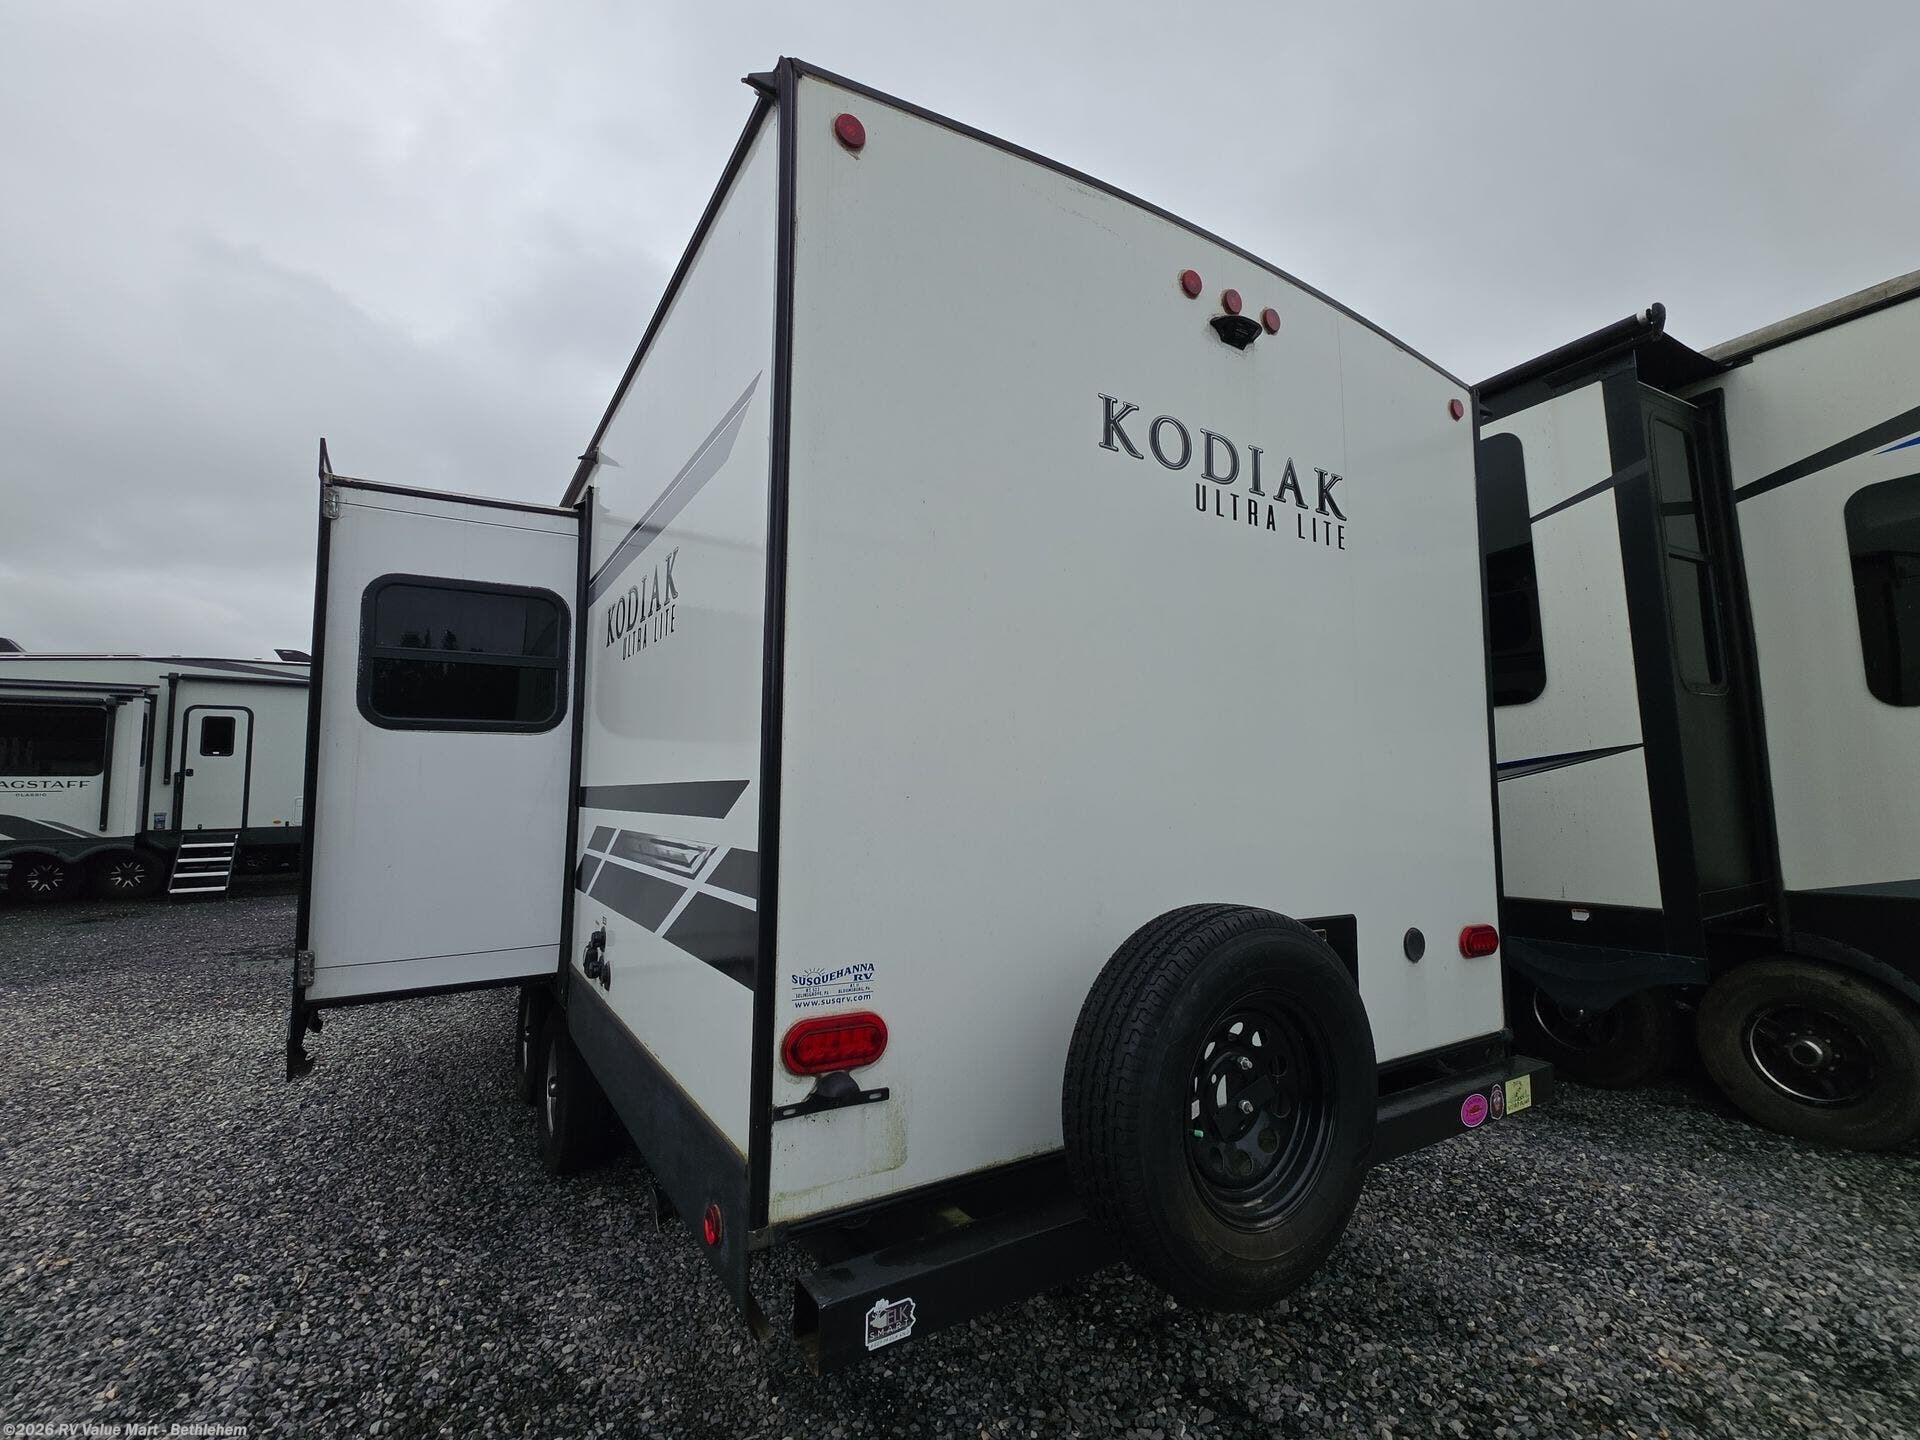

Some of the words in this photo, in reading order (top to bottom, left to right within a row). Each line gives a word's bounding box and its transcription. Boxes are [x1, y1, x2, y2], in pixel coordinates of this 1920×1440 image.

[1098, 392, 1347, 521] KODIAK
[1195, 483, 1276, 531] ULTRA
[1298, 513, 1345, 550] LITE
[606, 546, 679, 648] KODIAK
[654, 604, 675, 643] LITE
[791, 963, 875, 986] SUSQUEHANNA
[853, 972, 873, 982] RV
[794, 994, 871, 1009] www.susqrv.com
